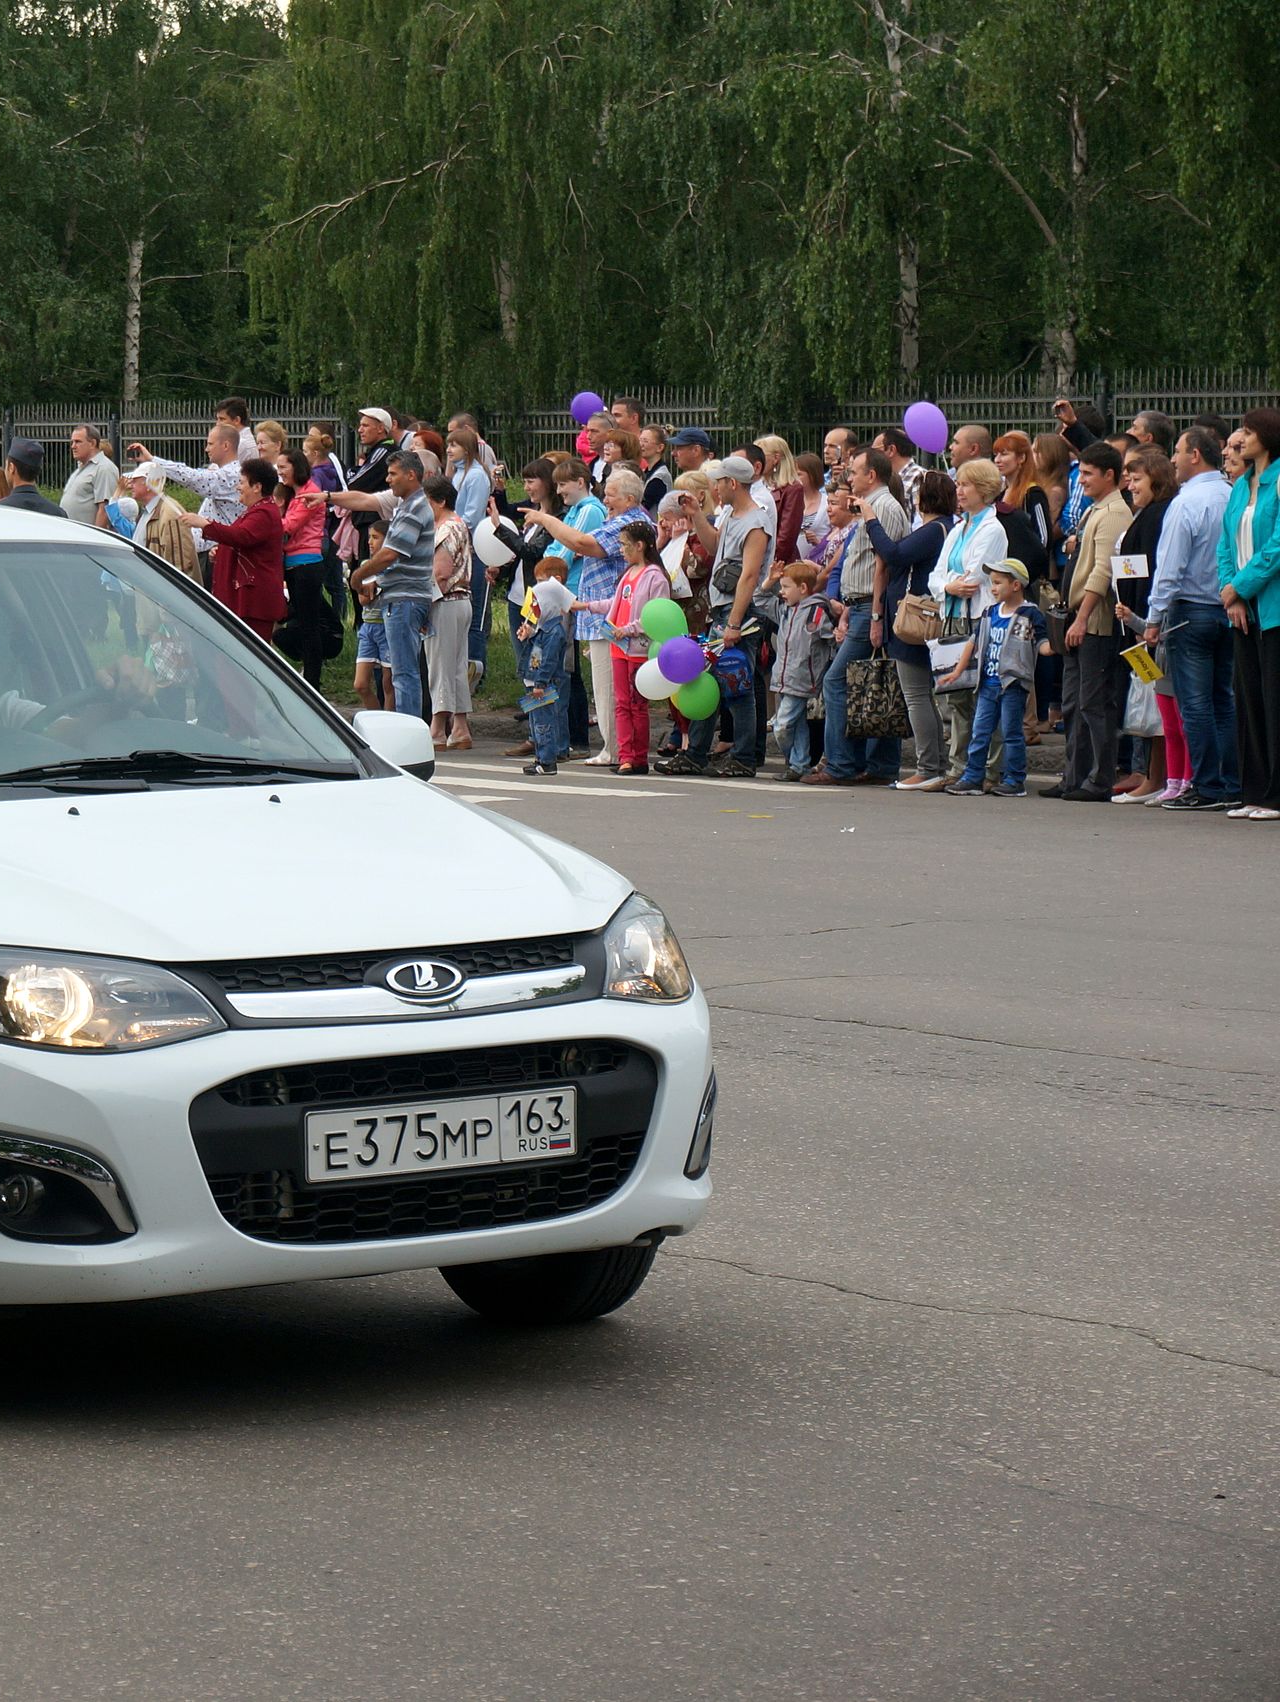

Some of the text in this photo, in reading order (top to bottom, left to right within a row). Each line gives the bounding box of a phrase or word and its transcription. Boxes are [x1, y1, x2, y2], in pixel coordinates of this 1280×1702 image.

[325, 1095, 564, 1170] Е375МР 163
[519, 1136, 548, 1152] RUS
